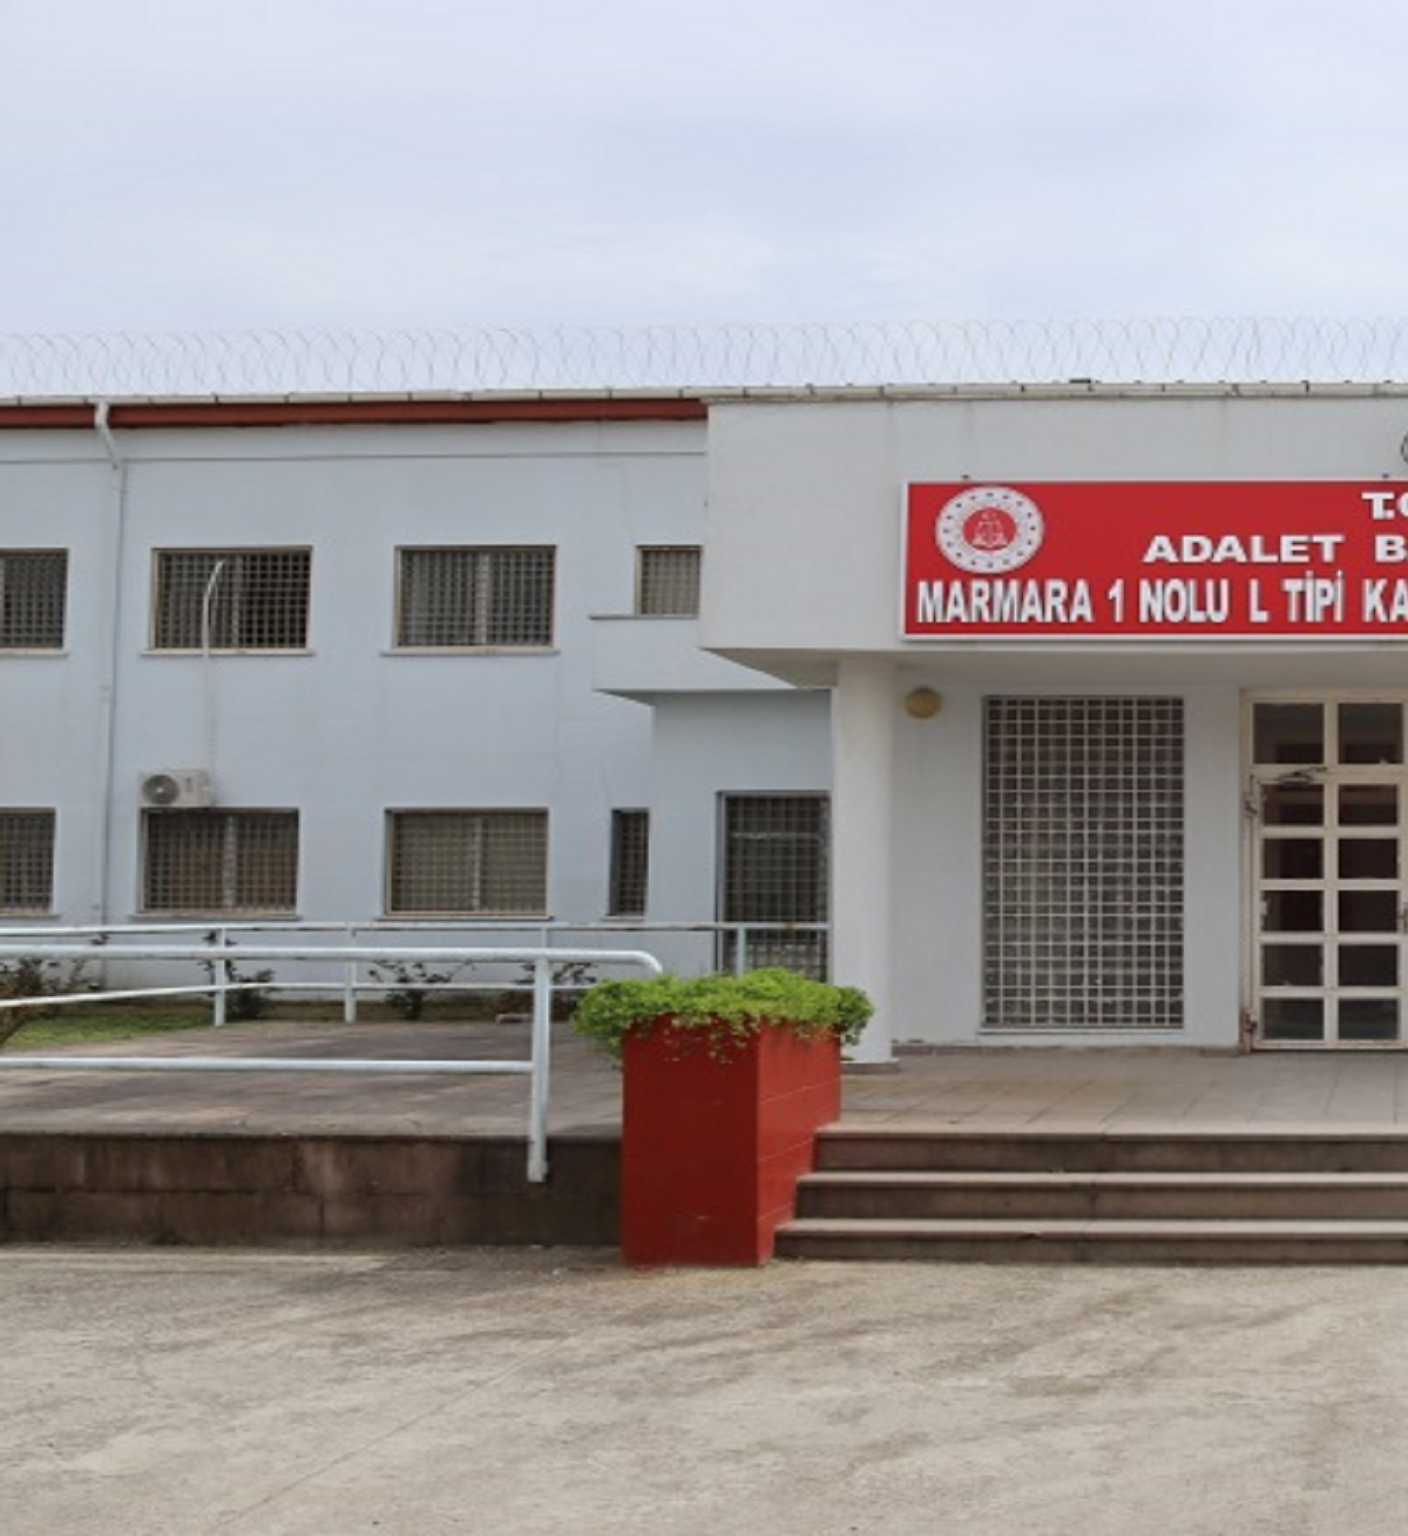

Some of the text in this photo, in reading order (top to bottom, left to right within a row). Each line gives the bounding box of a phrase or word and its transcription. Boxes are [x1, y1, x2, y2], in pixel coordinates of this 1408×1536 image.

[1142, 534, 1345, 563] ADALET
[917, 578, 1093, 623] MARMARA
[1108, 578, 1124, 623] 1
[1139, 578, 1229, 623] NOLU
[1249, 578, 1269, 623] L
[1282, 570, 1344, 623] TİPİ
